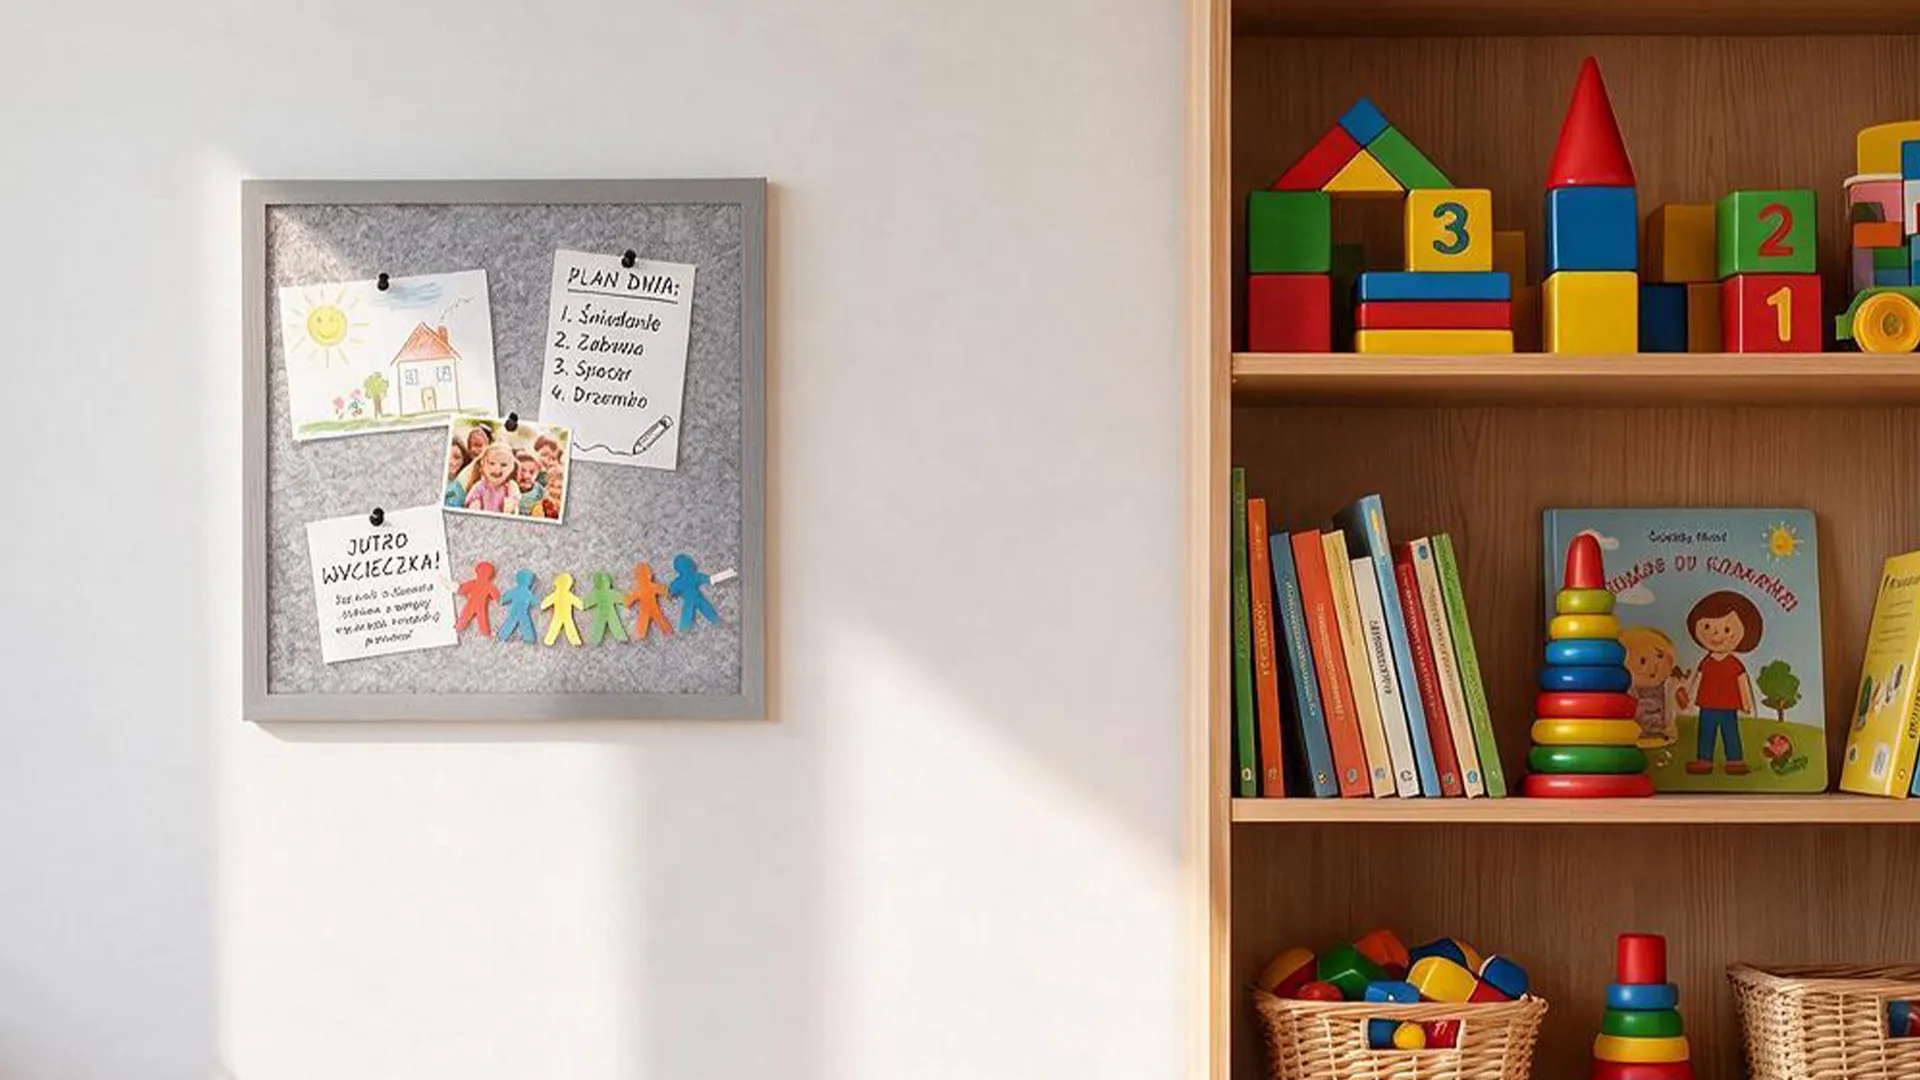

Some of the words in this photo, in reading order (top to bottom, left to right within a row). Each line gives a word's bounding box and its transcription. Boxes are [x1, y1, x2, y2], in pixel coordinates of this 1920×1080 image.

[1433, 202, 1469, 254] 3
[1758, 203, 1794, 256] 2
[567, 266, 619, 288] PLAN
[561, 304, 572, 323] 1.
[1767, 286, 1791, 341] 1
[554, 331, 570, 349] 2.
[554, 357, 569, 376] 3.
[551, 384, 565, 401] 4.
[348, 533, 408, 555] JUTRO
